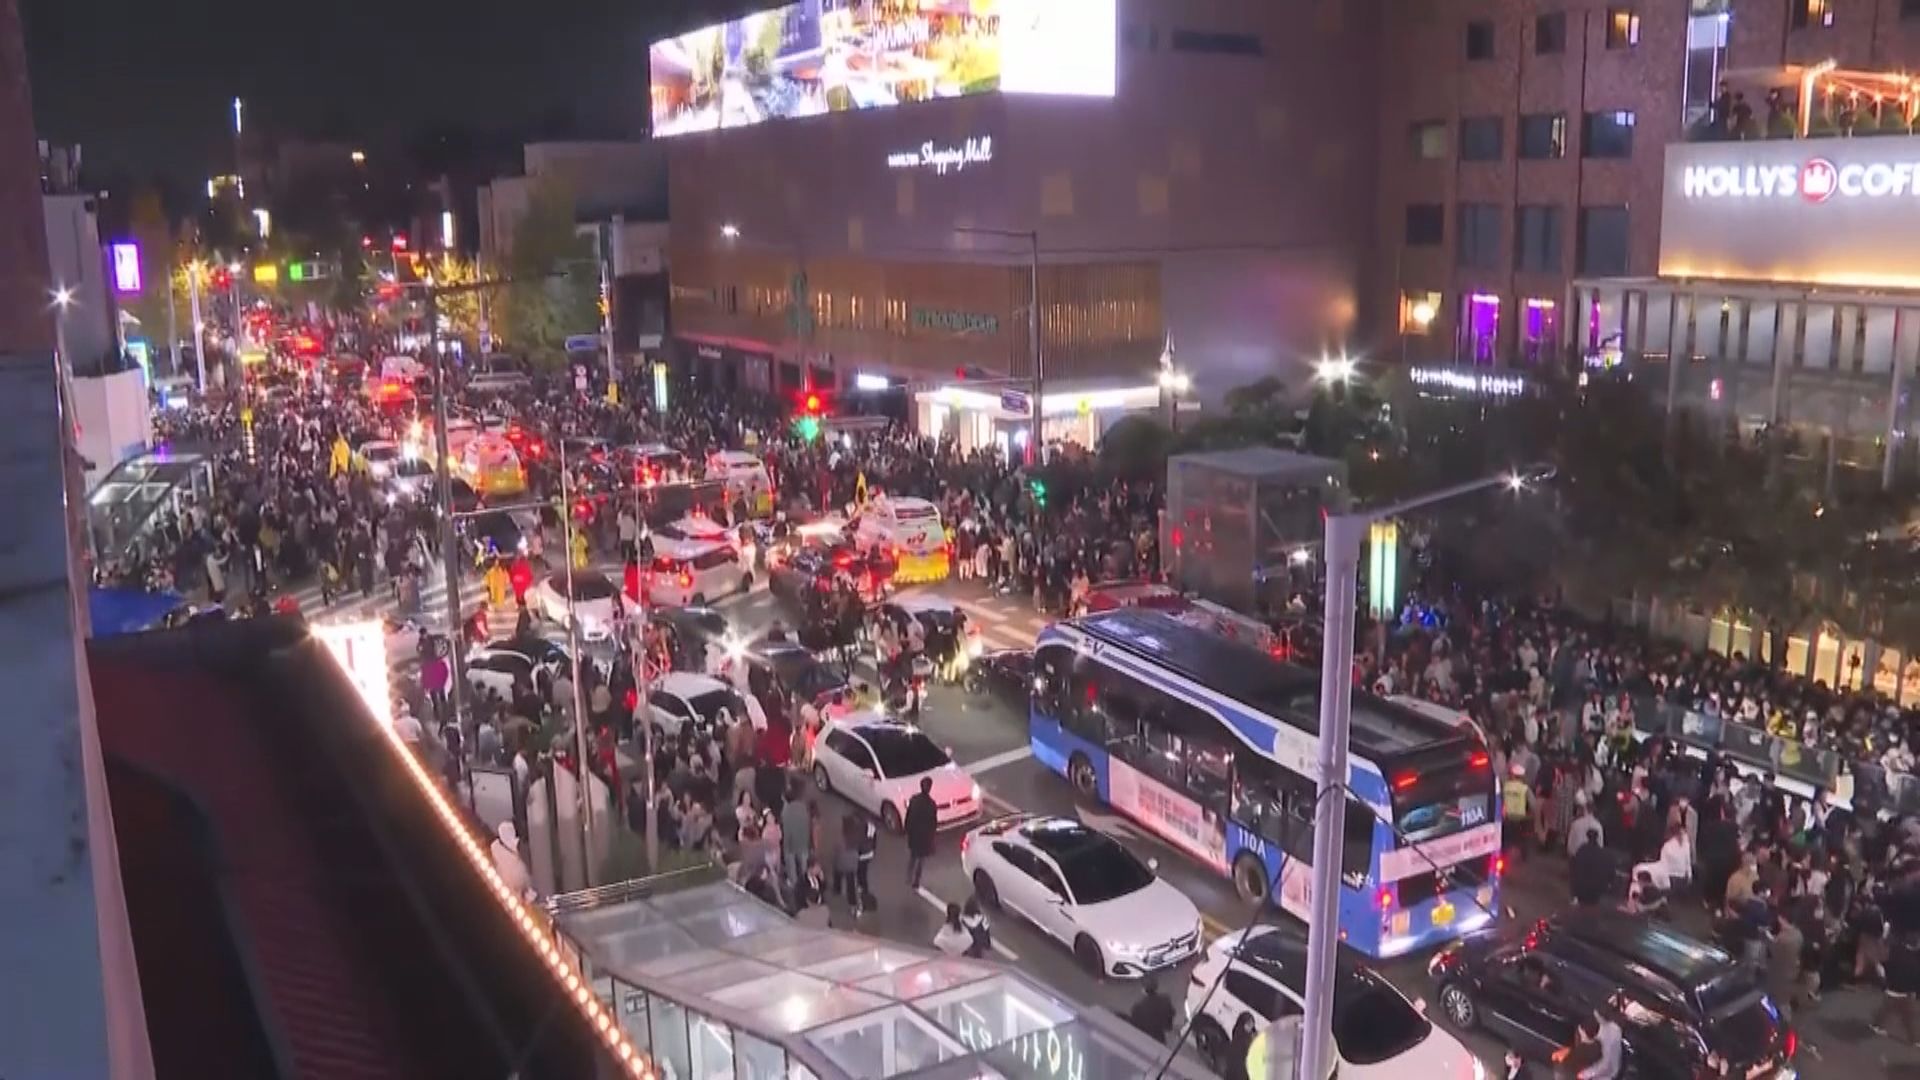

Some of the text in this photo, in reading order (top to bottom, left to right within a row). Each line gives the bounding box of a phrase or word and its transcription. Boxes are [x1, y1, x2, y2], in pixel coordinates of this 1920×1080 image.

[920, 139, 963, 175] Shopping
[963, 133, 993, 163] Mall
[1684, 165, 1798, 198] HOLLYS
[1239, 827, 1267, 860] 110A
